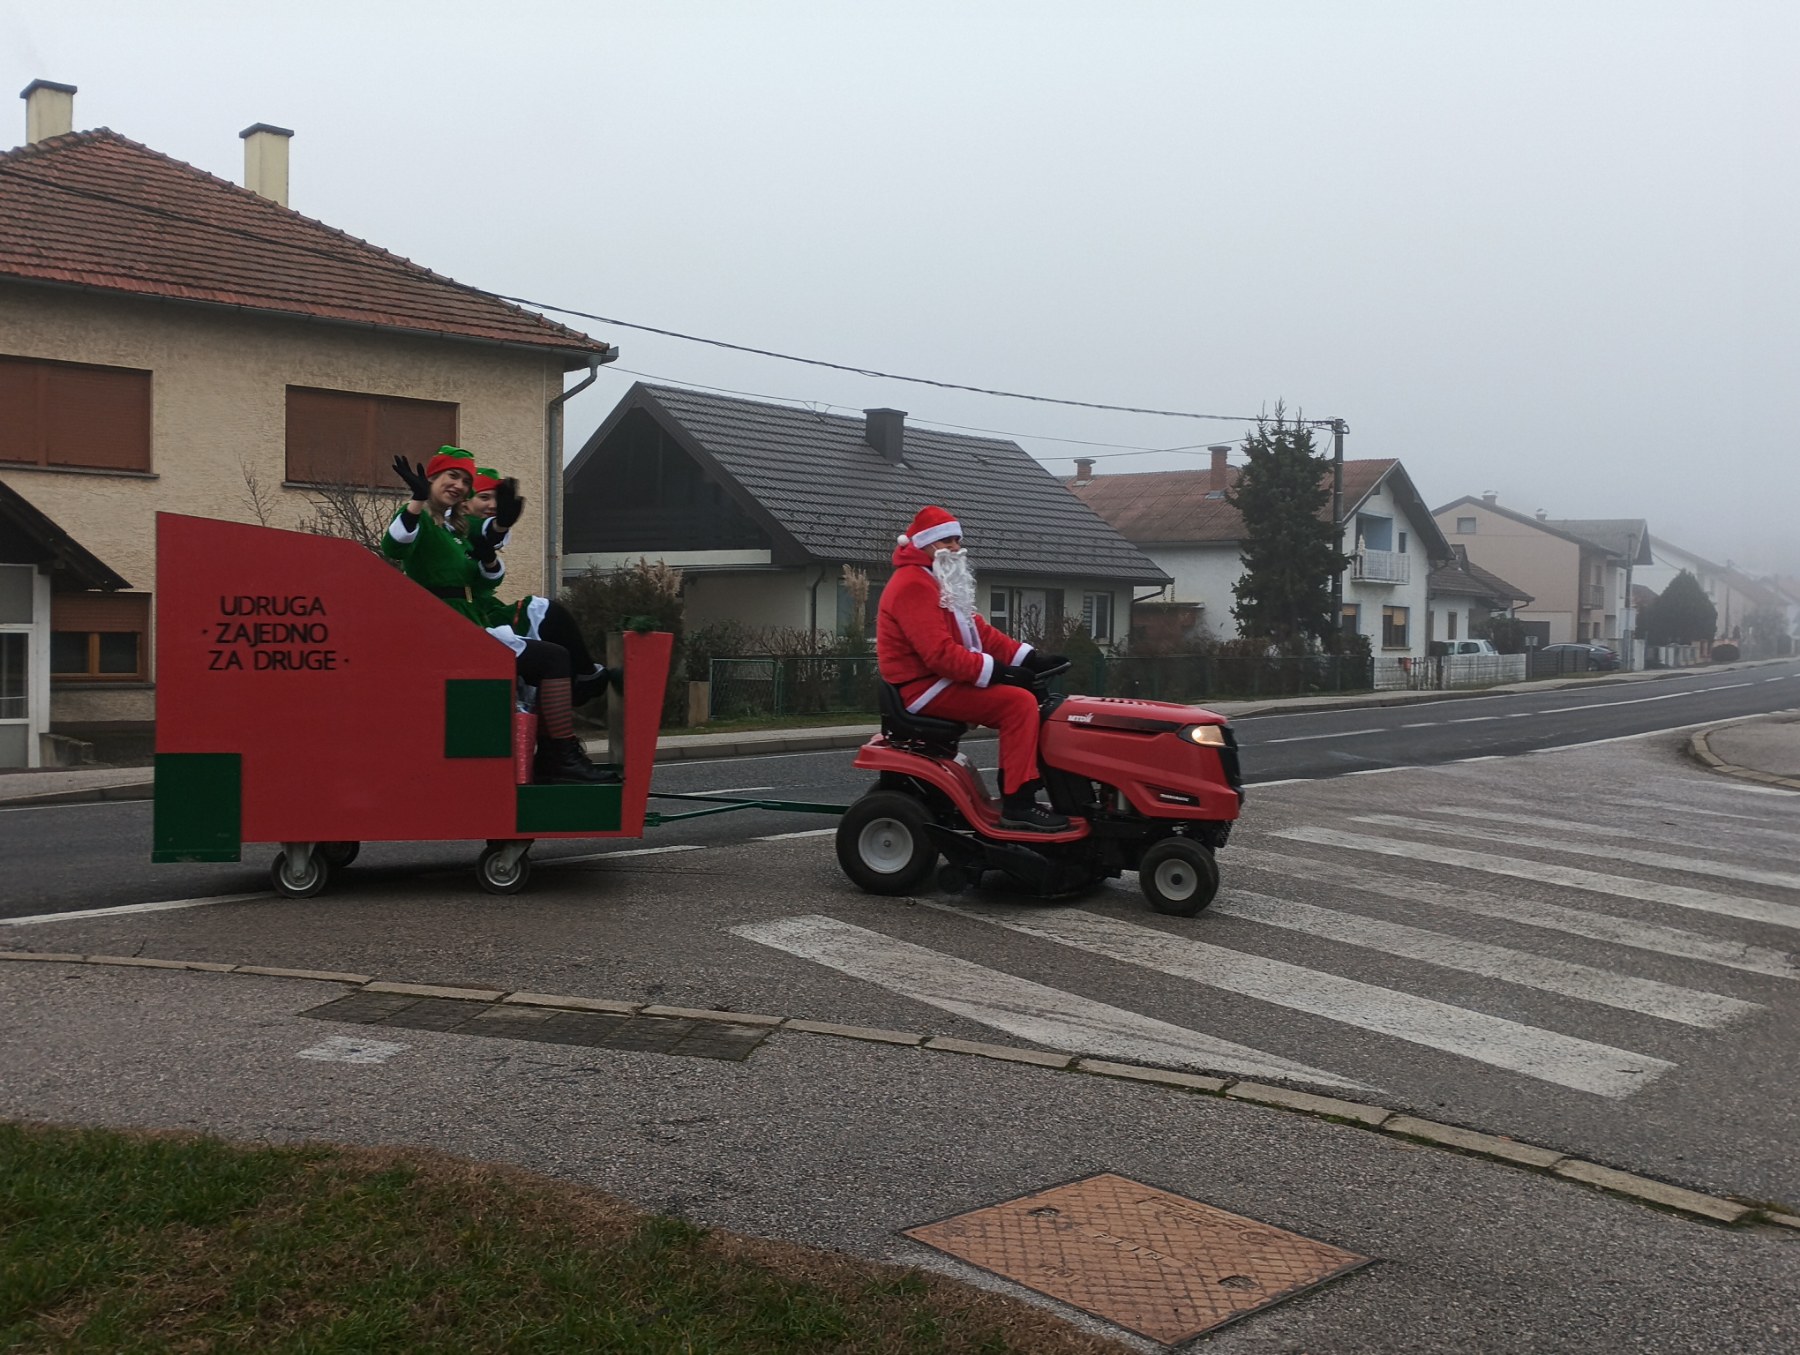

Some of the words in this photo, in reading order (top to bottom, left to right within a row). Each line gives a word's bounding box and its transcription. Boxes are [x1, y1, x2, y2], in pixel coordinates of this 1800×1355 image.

[220, 596, 326, 616] UDRUGA
[215, 623, 329, 647] ZAJEDNO
[208, 650, 244, 671] ZA
[253, 650, 337, 671] DRUGE
